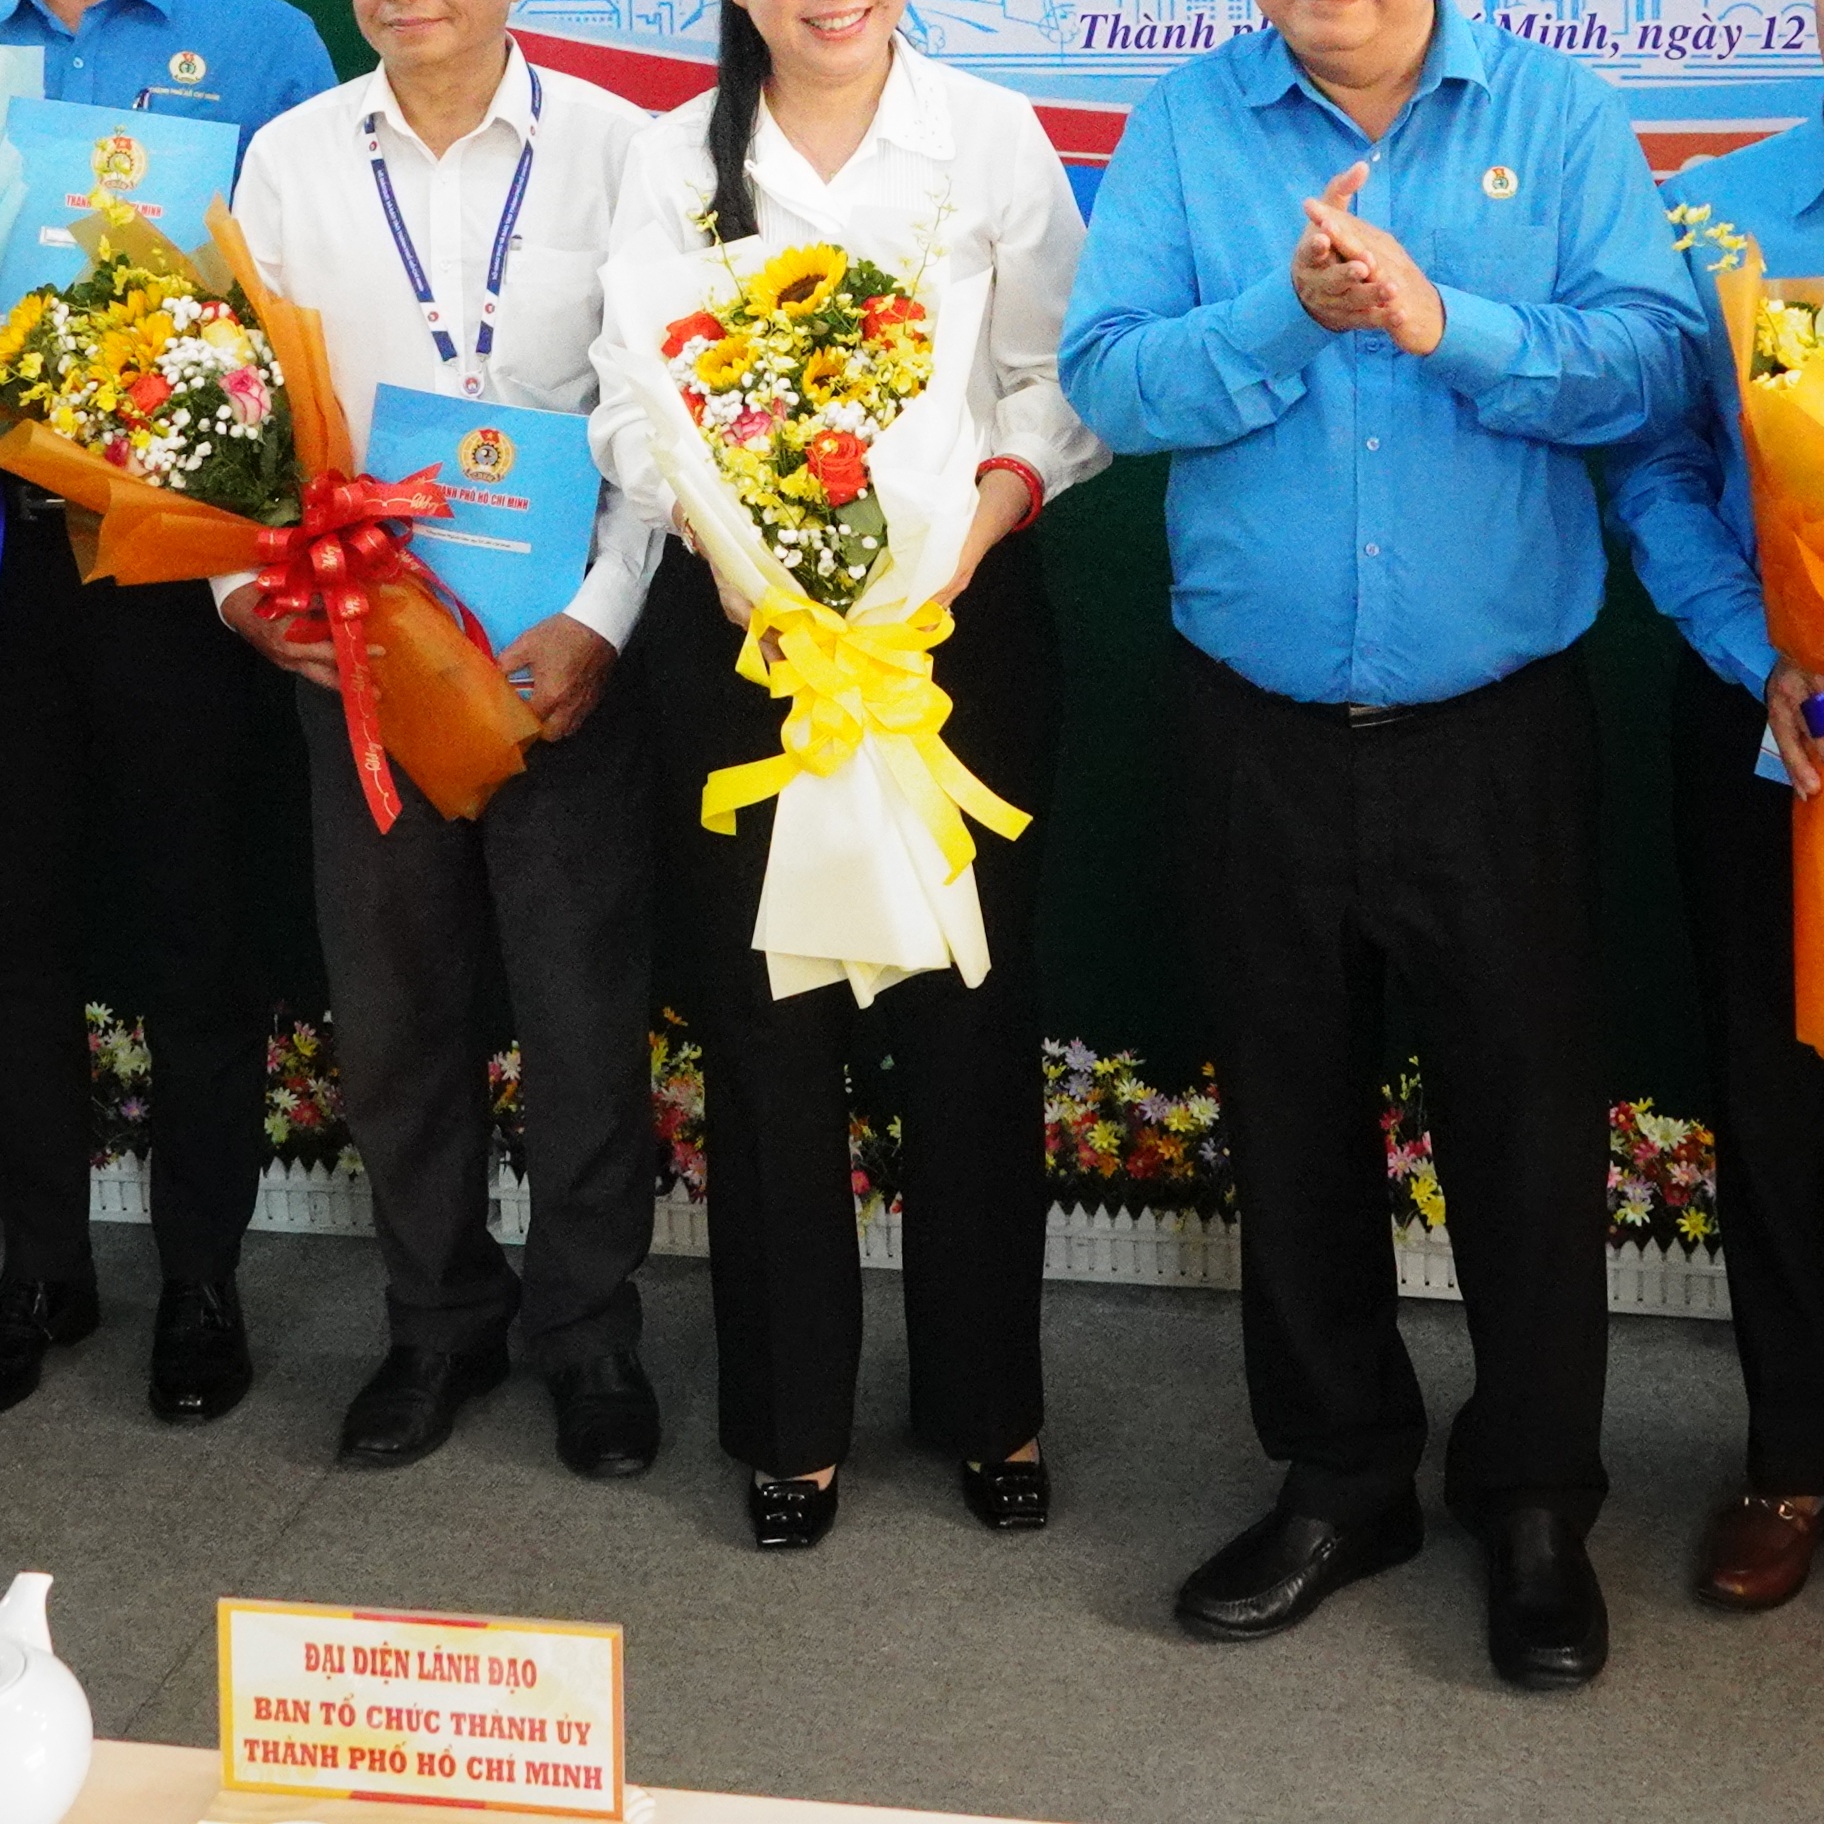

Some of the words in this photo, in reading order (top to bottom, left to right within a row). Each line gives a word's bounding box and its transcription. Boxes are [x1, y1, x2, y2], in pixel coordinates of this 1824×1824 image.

[1079, 11, 1215, 51] Thành
[1637, 12, 1742, 60] ngày
[1761, 14, 1805, 51] 12
[305, 1642, 345, 1681] ĐẠI
[352, 1640, 411, 1686] DIỆN
[487, 1656, 538, 1695] ĐẠO
[254, 1696, 311, 1725] BAN
[319, 1692, 357, 1728] TỔ
[366, 1702, 441, 1735] CHỨC
[450, 1707, 548, 1744] THÀNH
[556, 1712, 593, 1748] ỦY
[243, 1734, 340, 1769] THÀNH
[348, 1740, 409, 1775] PHỐ
[416, 1743, 457, 1779] HỒ
[466, 1753, 517, 1784] CHÍ
[525, 1761, 604, 1791] MINH
